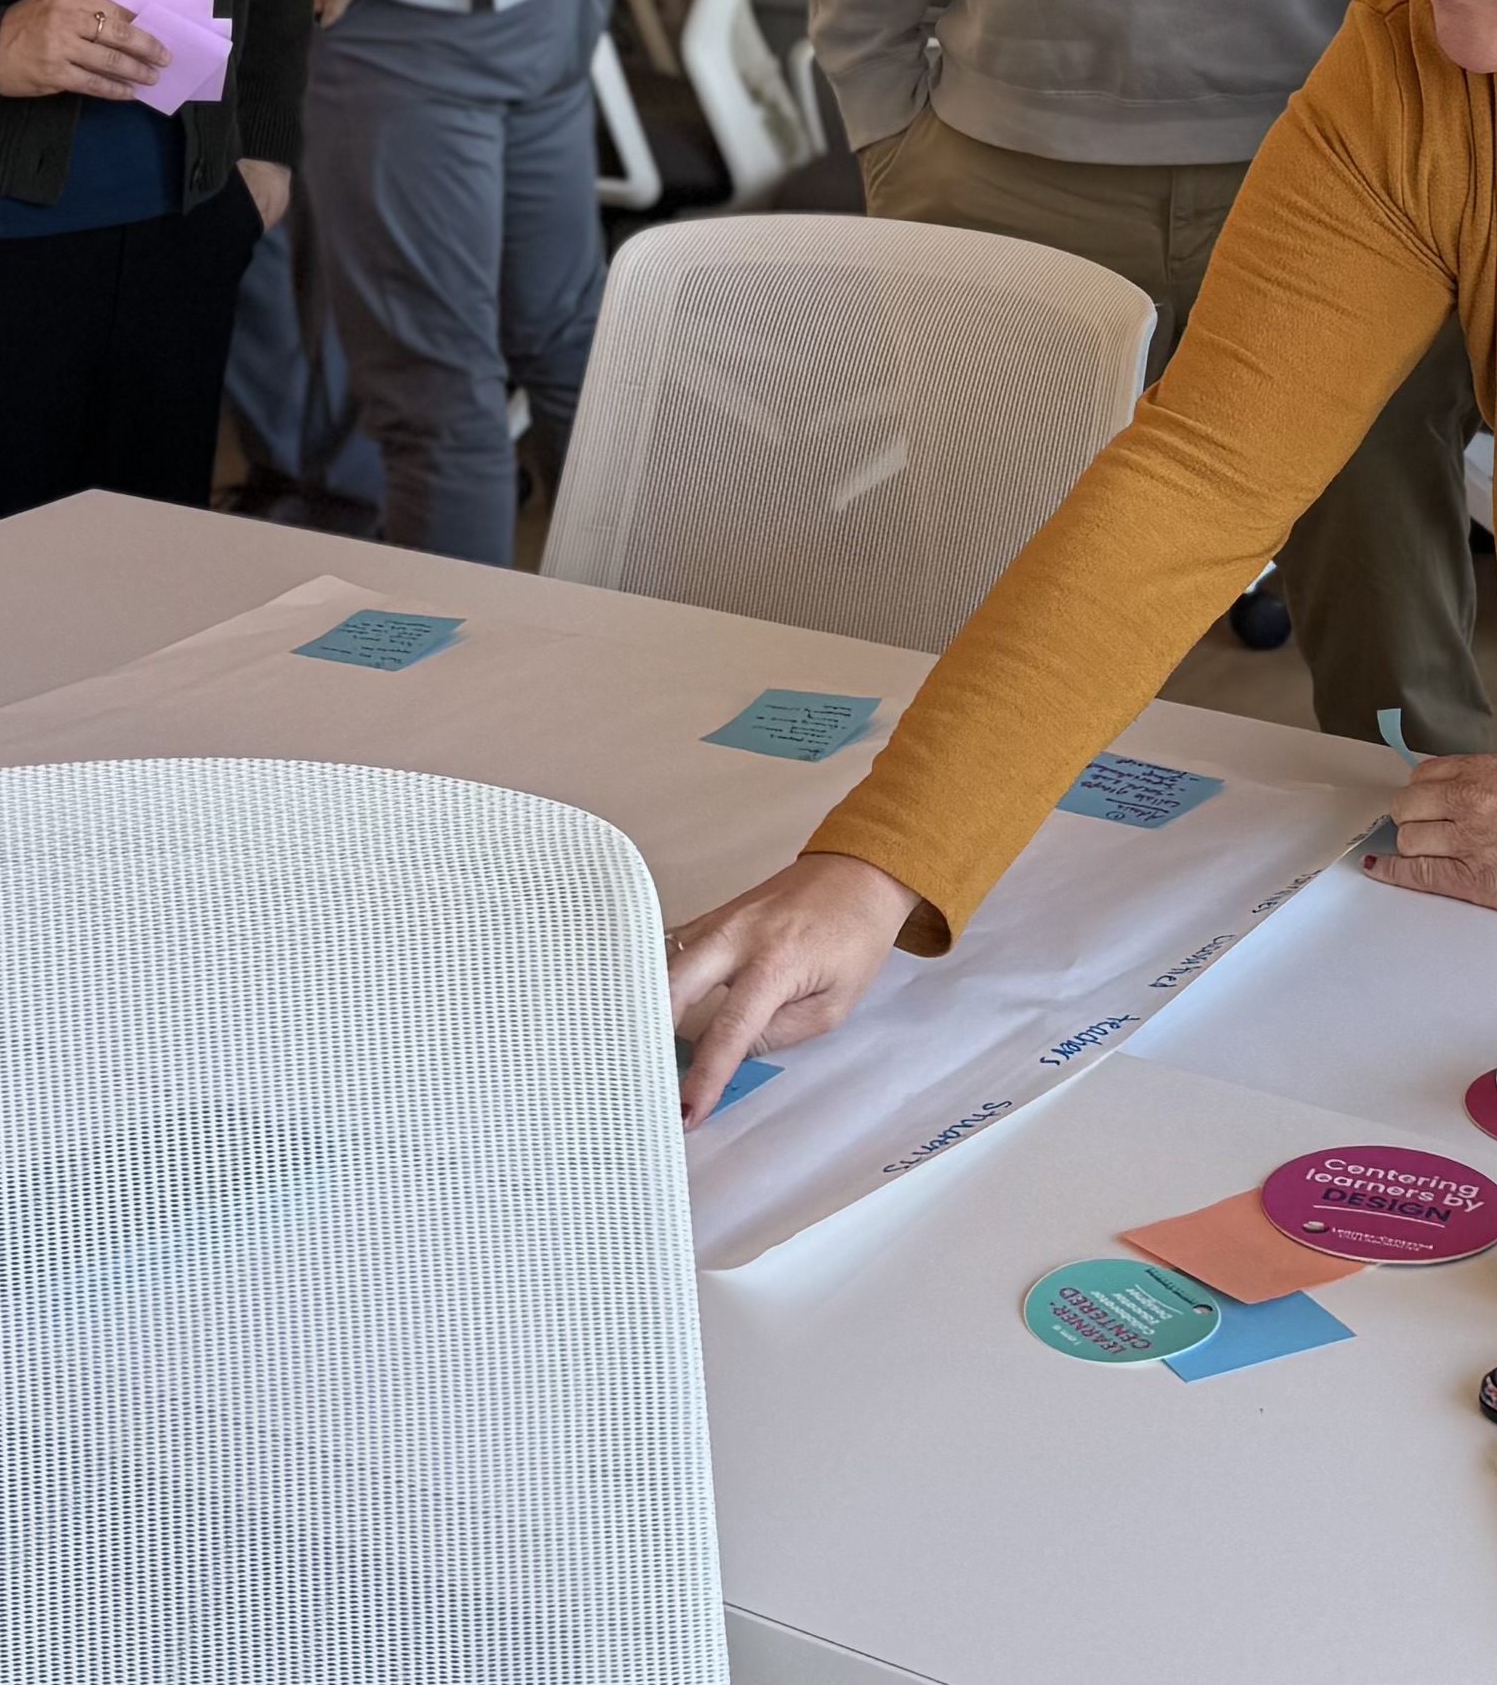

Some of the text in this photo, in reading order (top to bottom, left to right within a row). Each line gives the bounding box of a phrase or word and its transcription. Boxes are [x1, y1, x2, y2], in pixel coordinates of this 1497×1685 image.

[1306, 1168, 1484, 1212] learners by
[1324, 1158, 1480, 1199] Centering
[1321, 1187, 1451, 1223] DESIGN
[1059, 1287, 1152, 1349] CENTERED
